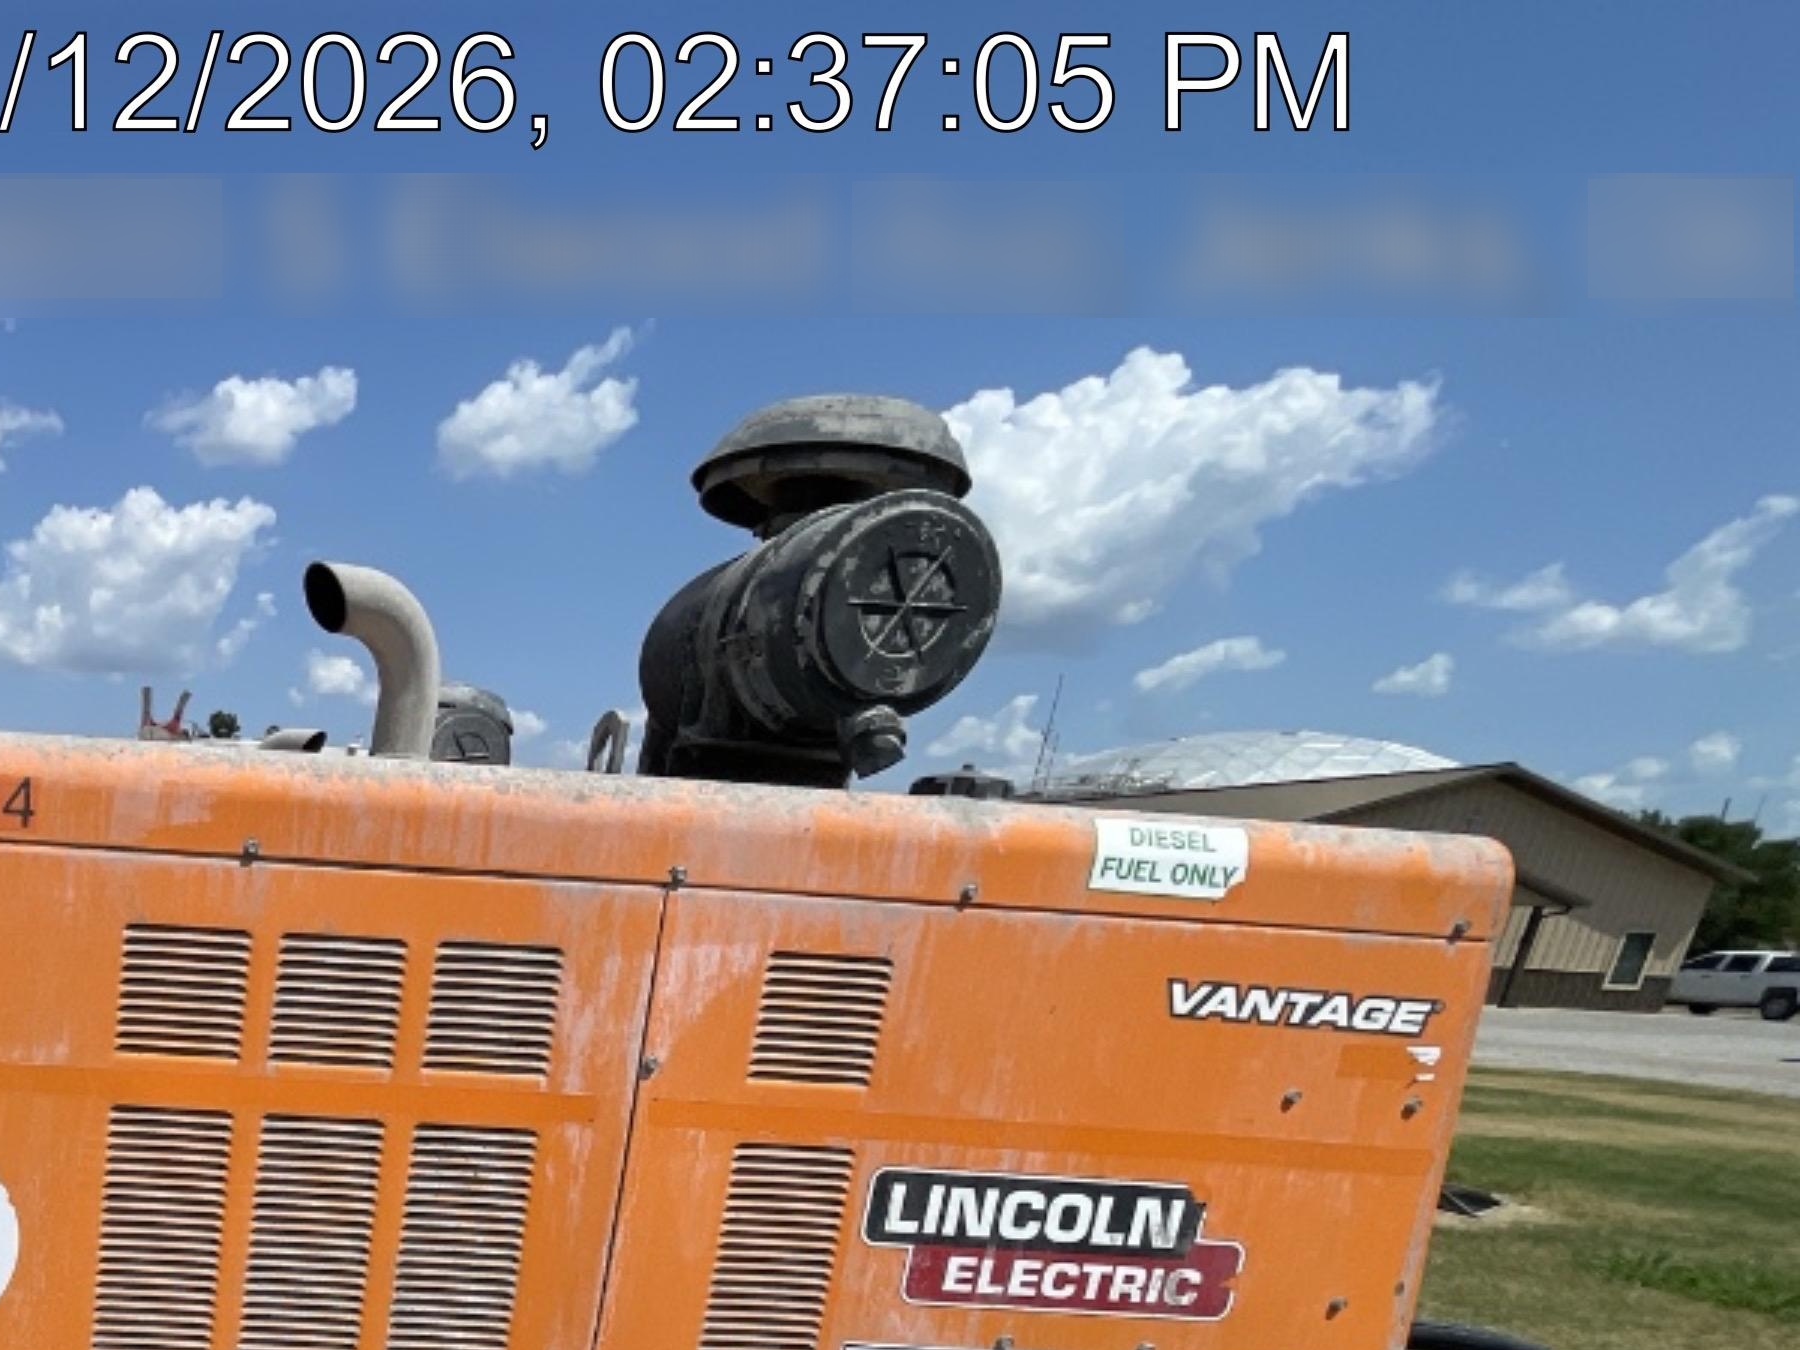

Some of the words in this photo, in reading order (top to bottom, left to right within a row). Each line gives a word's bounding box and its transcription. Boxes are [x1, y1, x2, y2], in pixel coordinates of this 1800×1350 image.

[1128, 826, 1218, 853] DIESEL
[1099, 856, 1162, 884] FUEL
[1170, 861, 1240, 889] ONLY
[1167, 978, 1438, 1038] VANTAGE
[883, 1182, 1188, 1249] LINCOLN
[941, 1255, 1205, 1306] ELECTRIC
